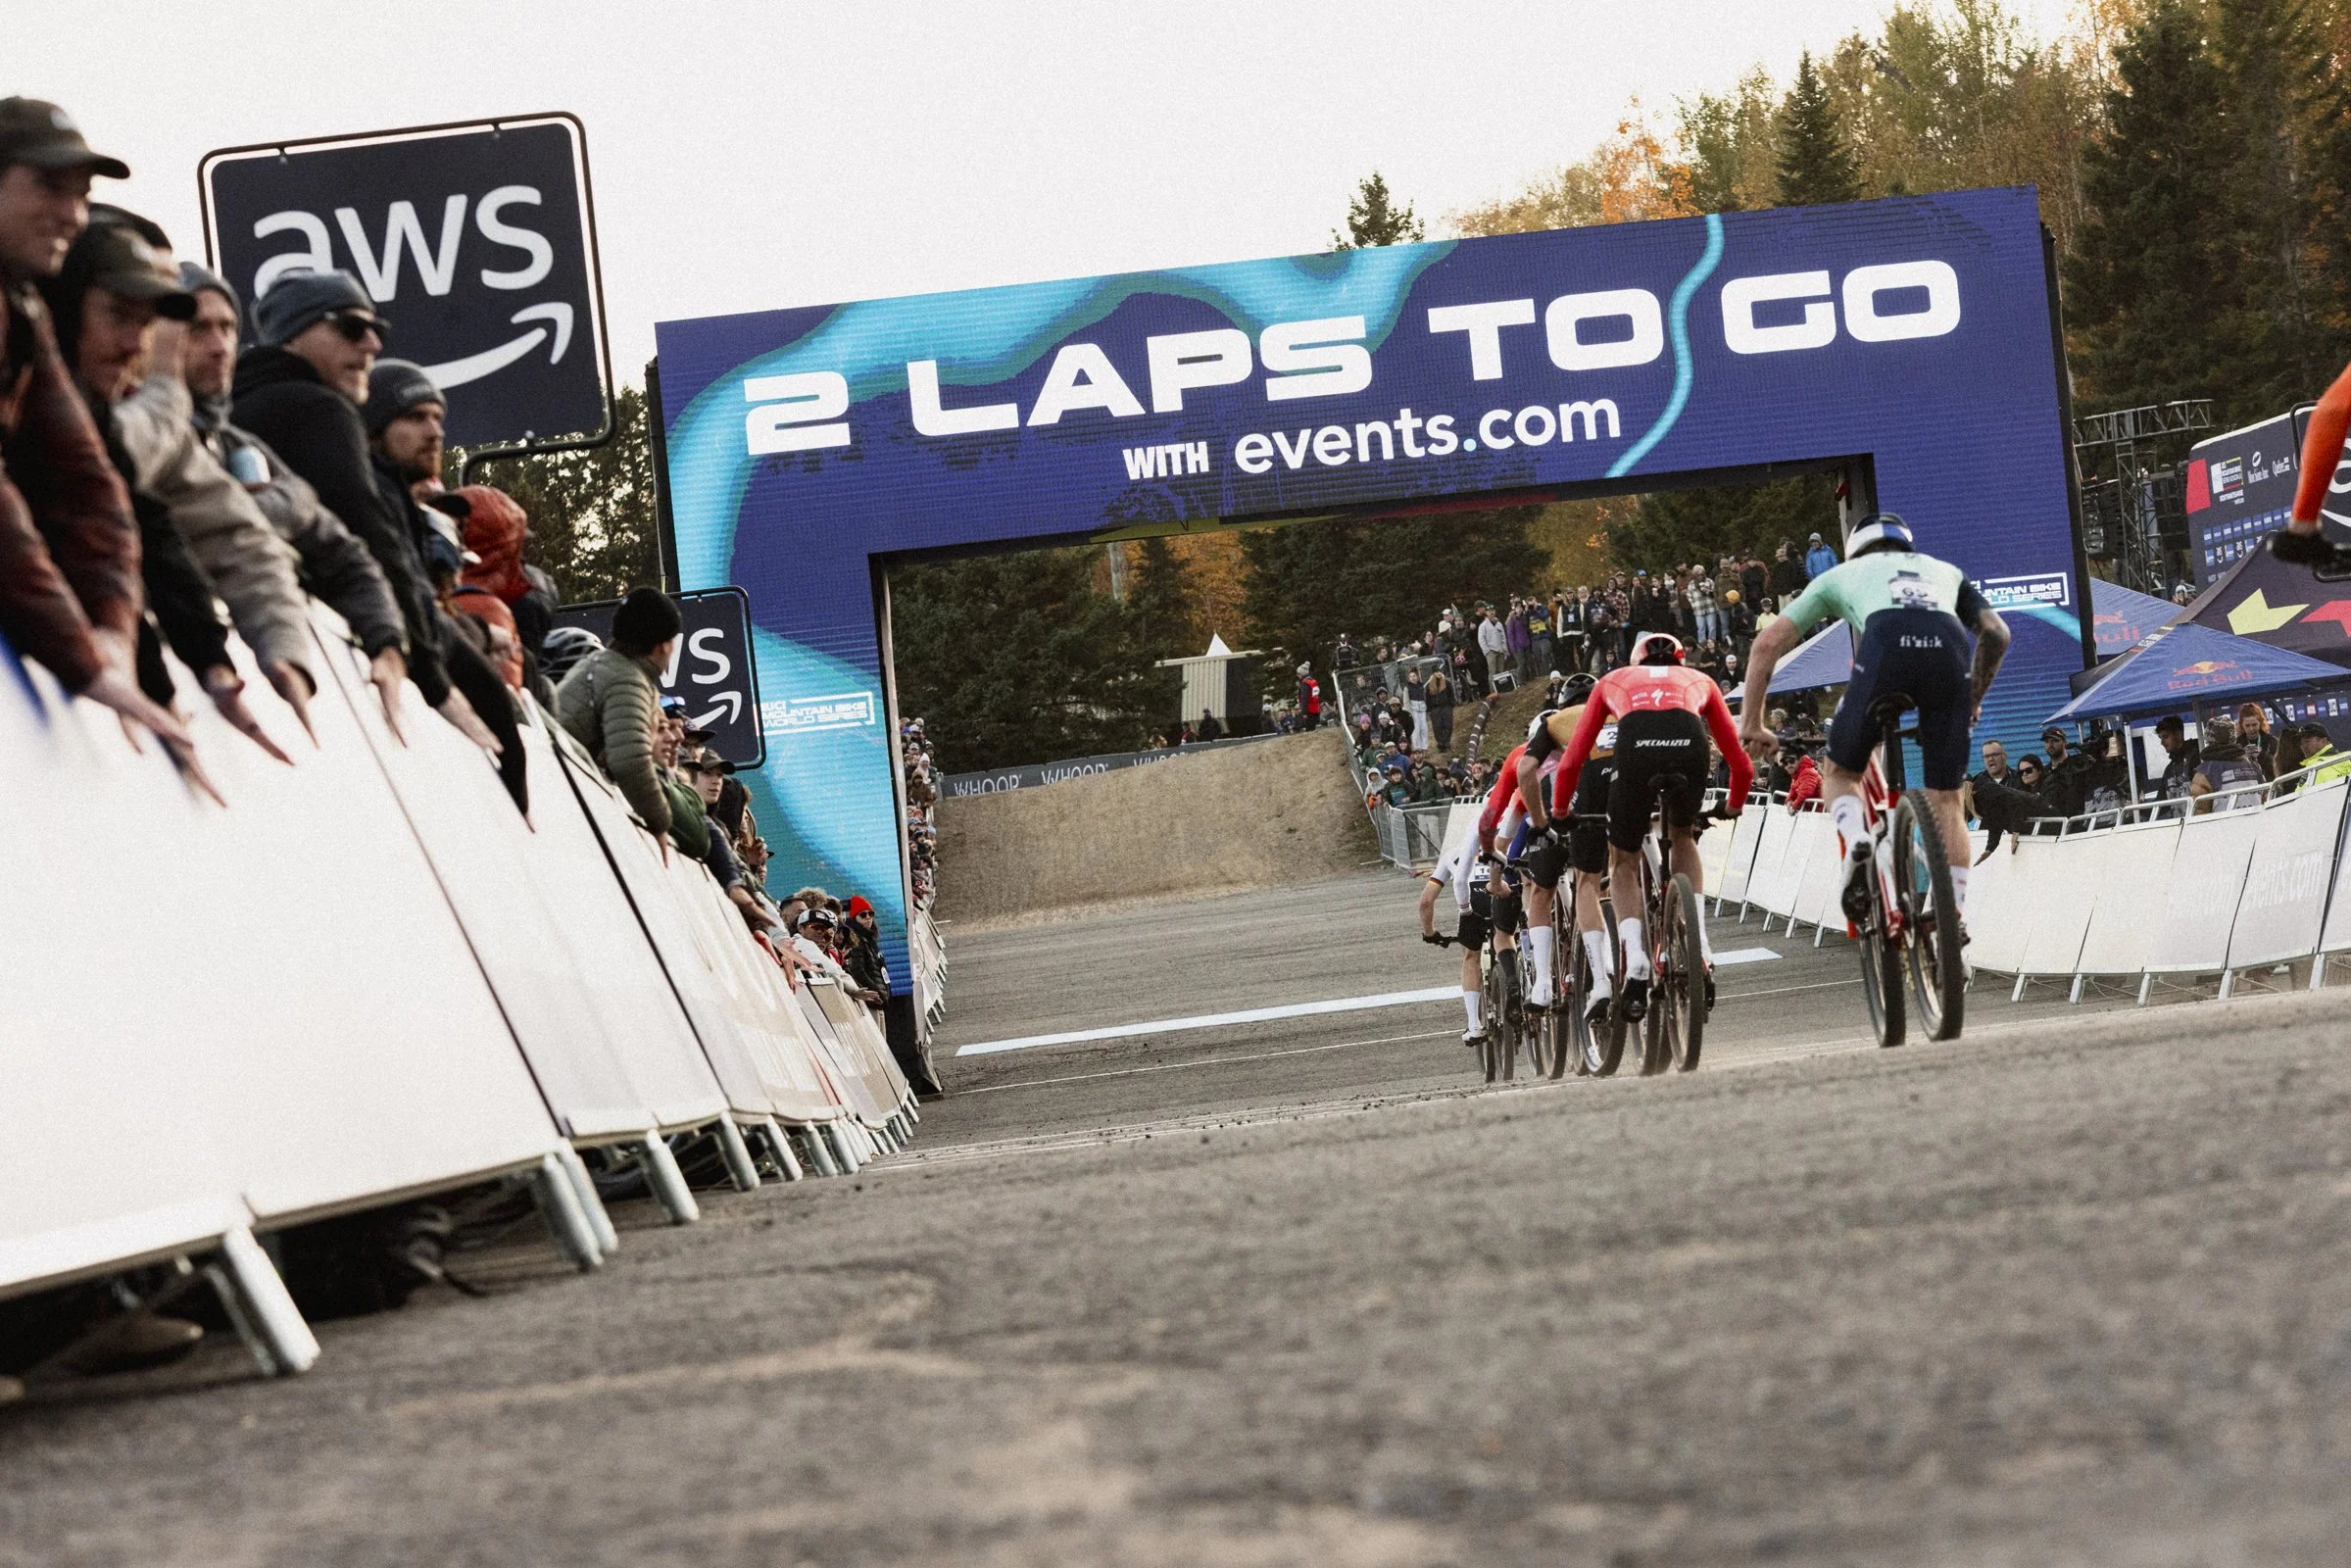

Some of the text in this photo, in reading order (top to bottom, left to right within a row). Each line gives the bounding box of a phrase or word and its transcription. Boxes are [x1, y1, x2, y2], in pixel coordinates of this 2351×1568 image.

[254, 185, 554, 303] aws
[743, 260, 1961, 456] 2 LAPS TO GO
[1122, 398, 1622, 481] WITH events.com
[2012, 591, 2063, 603] SERIES
[2030, 582, 2061, 593] BIKE
[2093, 625, 2141, 645] ull
[2167, 669, 2253, 691] Red Bull
[835, 702, 866, 712] BIKE
[1634, 738, 1691, 749] SPECIALIZED
[954, 773, 1020, 797] WHOOP
